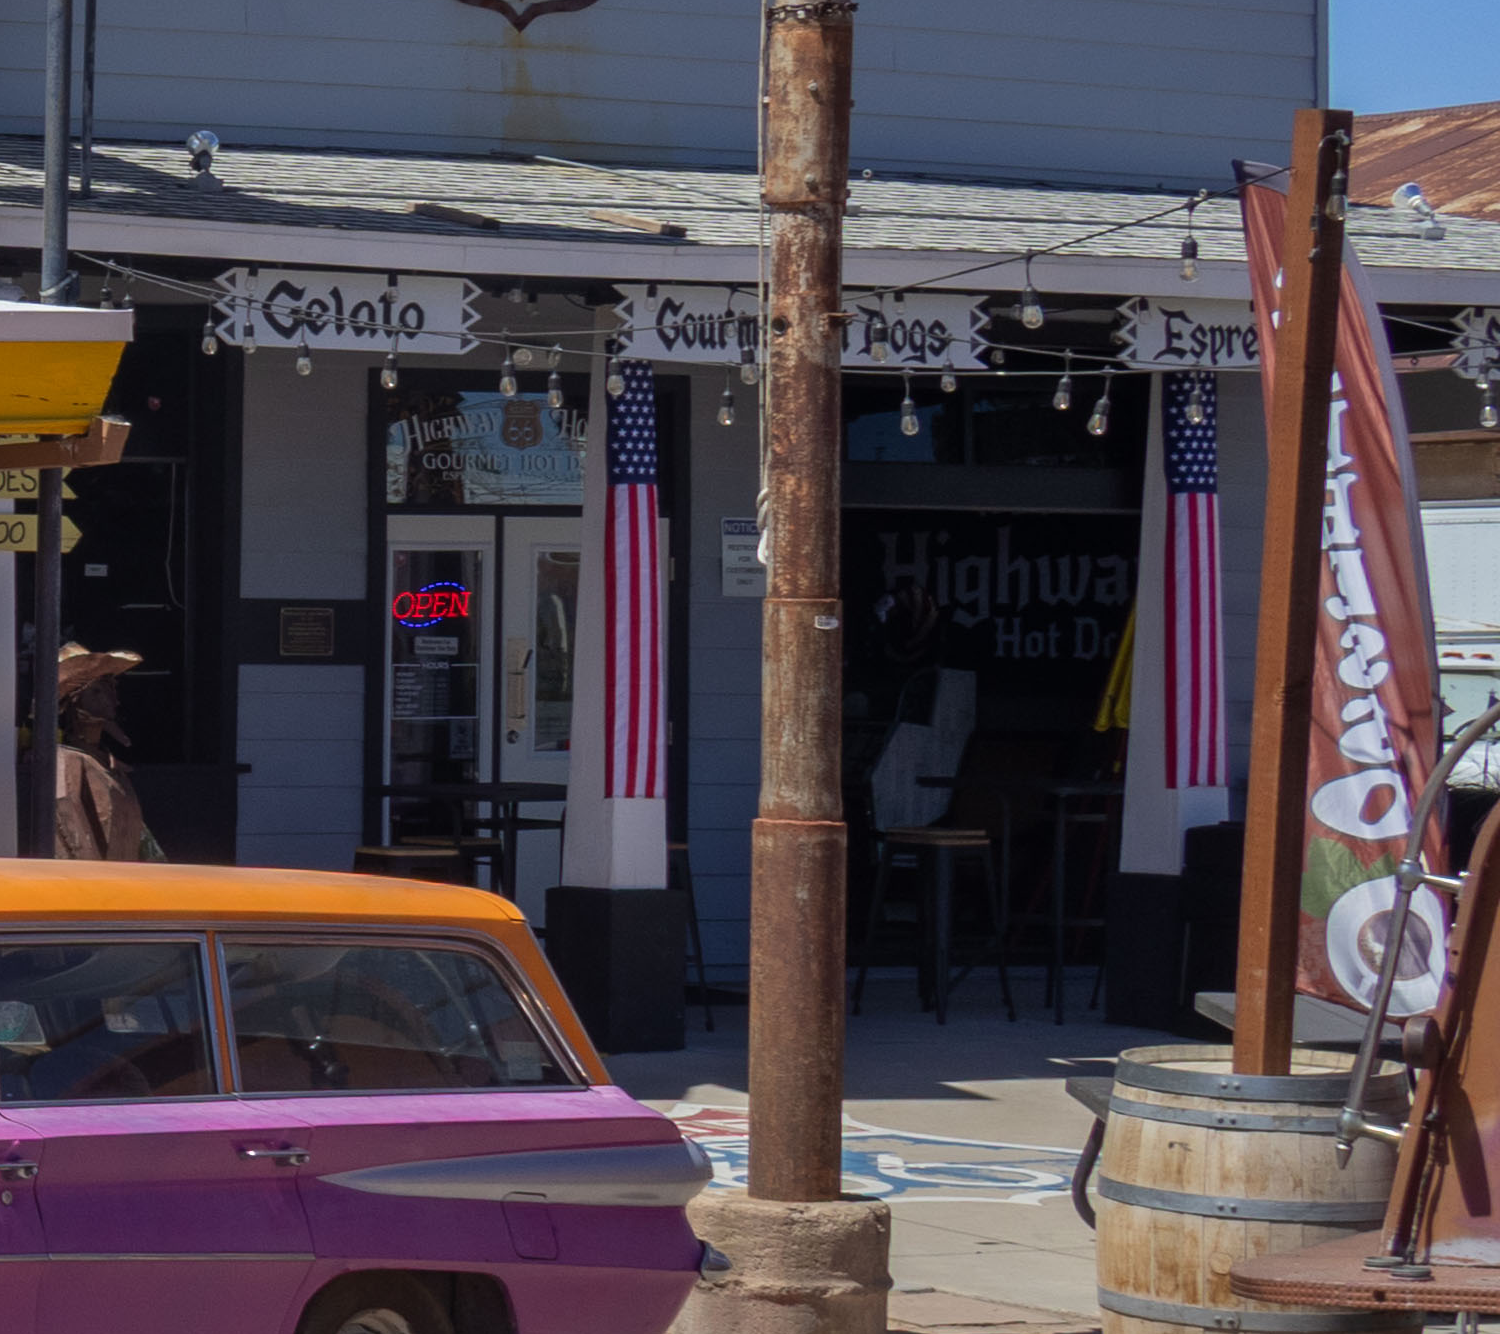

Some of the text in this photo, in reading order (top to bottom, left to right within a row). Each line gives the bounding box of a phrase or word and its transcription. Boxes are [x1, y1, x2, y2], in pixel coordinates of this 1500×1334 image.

[261, 280, 425, 340] Gelato
[856, 304, 952, 363] Dogs
[1153, 306, 1260, 365] Espre
[724, 522, 758, 533] NOTIC
[392, 591, 472, 619] OPEN
[877, 523, 1139, 629] Highwa
[994, 616, 1061, 659] Hot
